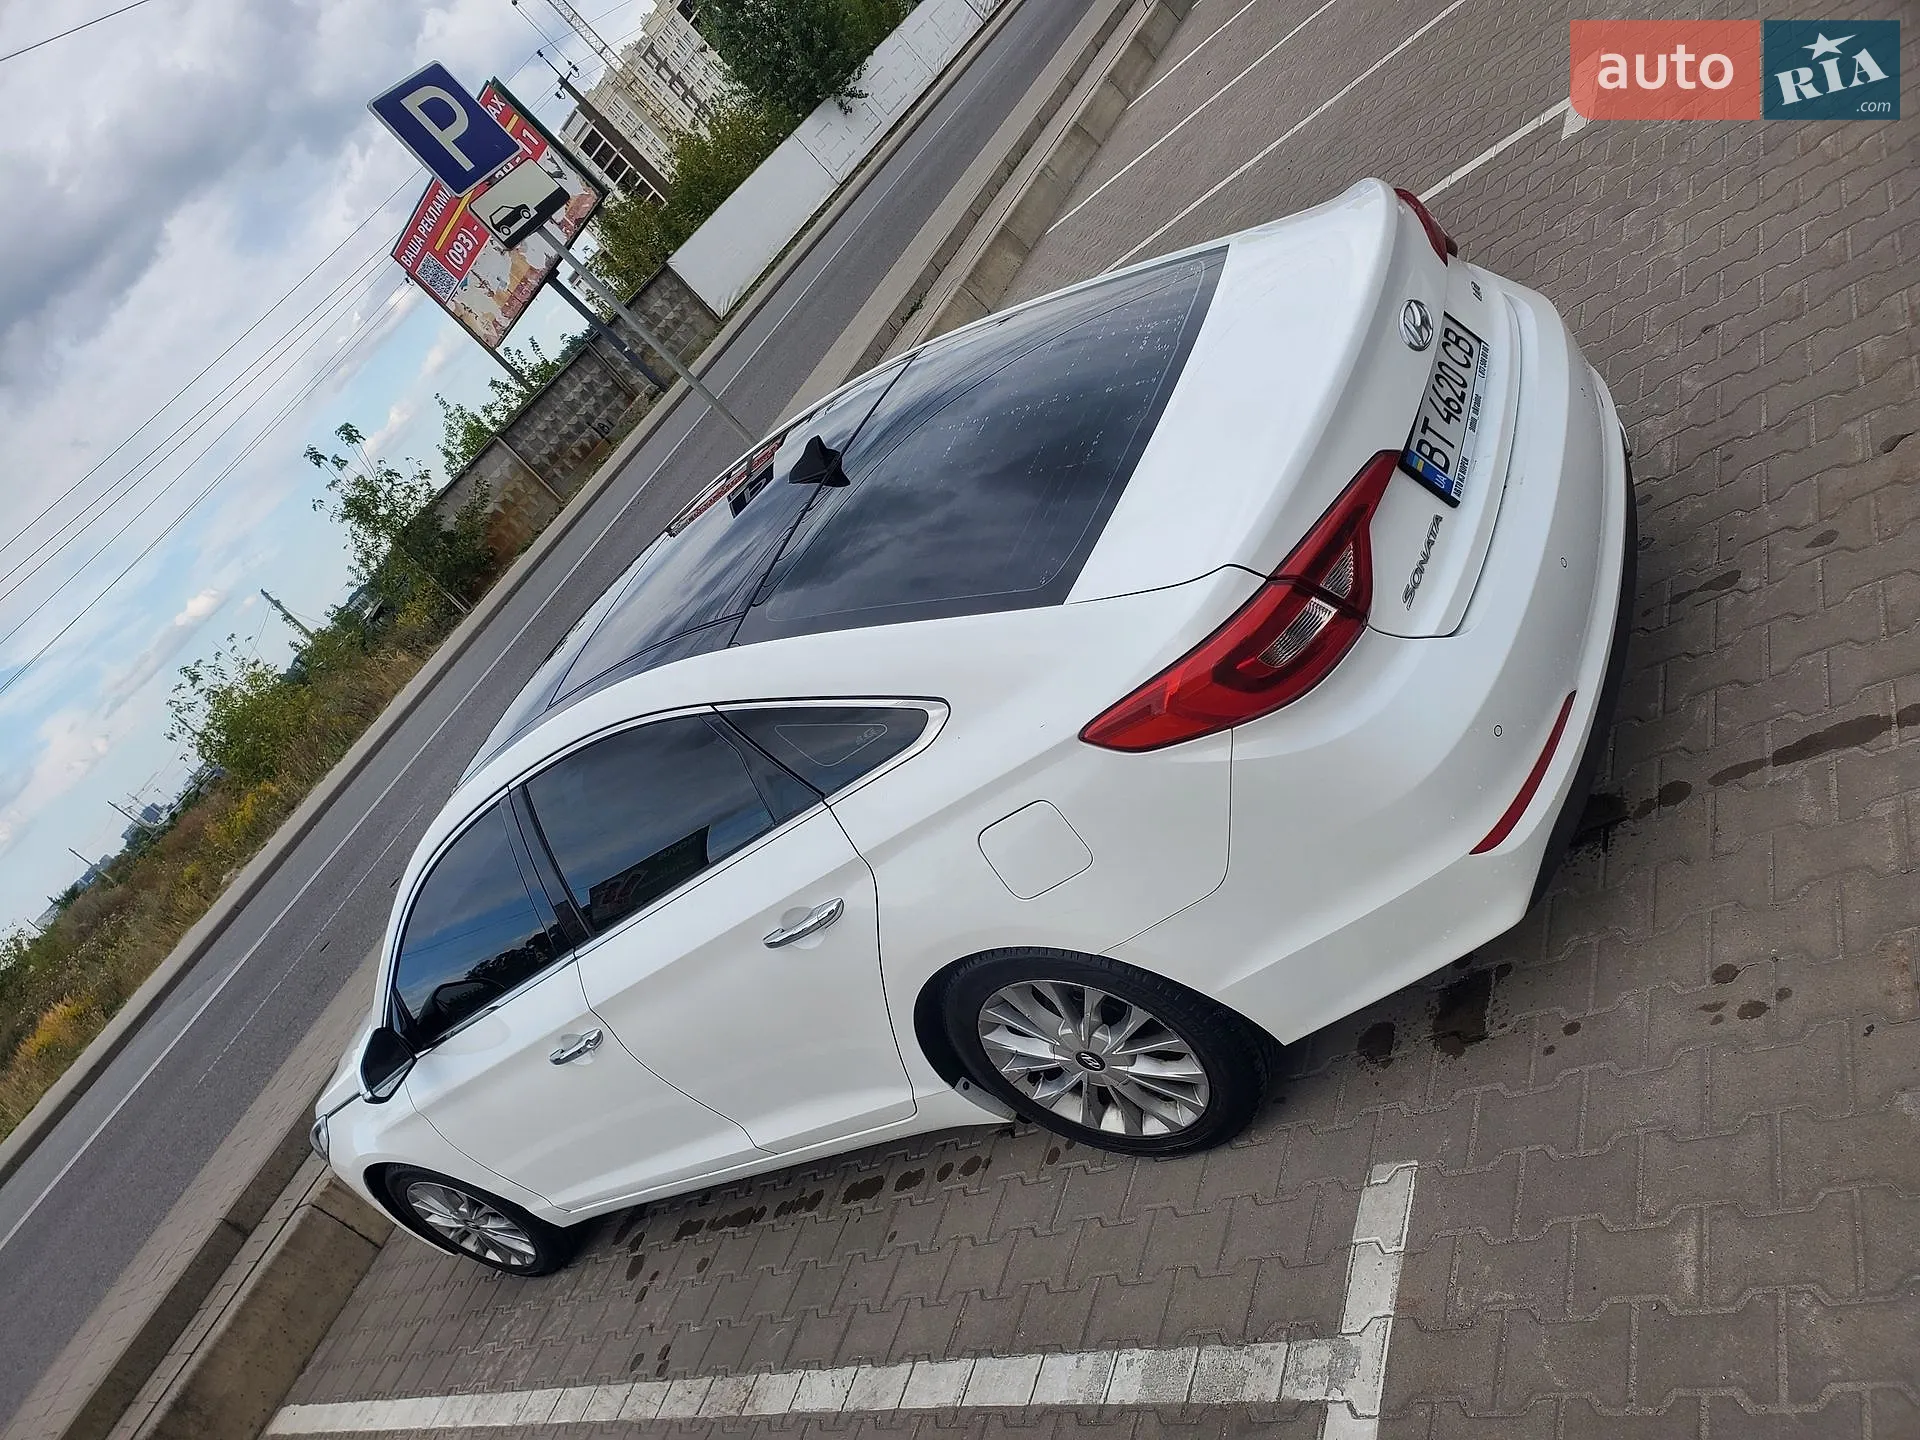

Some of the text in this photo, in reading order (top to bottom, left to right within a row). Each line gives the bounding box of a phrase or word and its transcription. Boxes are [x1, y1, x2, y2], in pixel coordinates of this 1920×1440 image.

[400, 85, 475, 172] P
[400, 233, 425, 268] ВАША
[1416, 327, 1474, 475] BT 4620 CB
[1434, 474, 1447, 489] UA
[1402, 514, 1443, 611] SONATA
